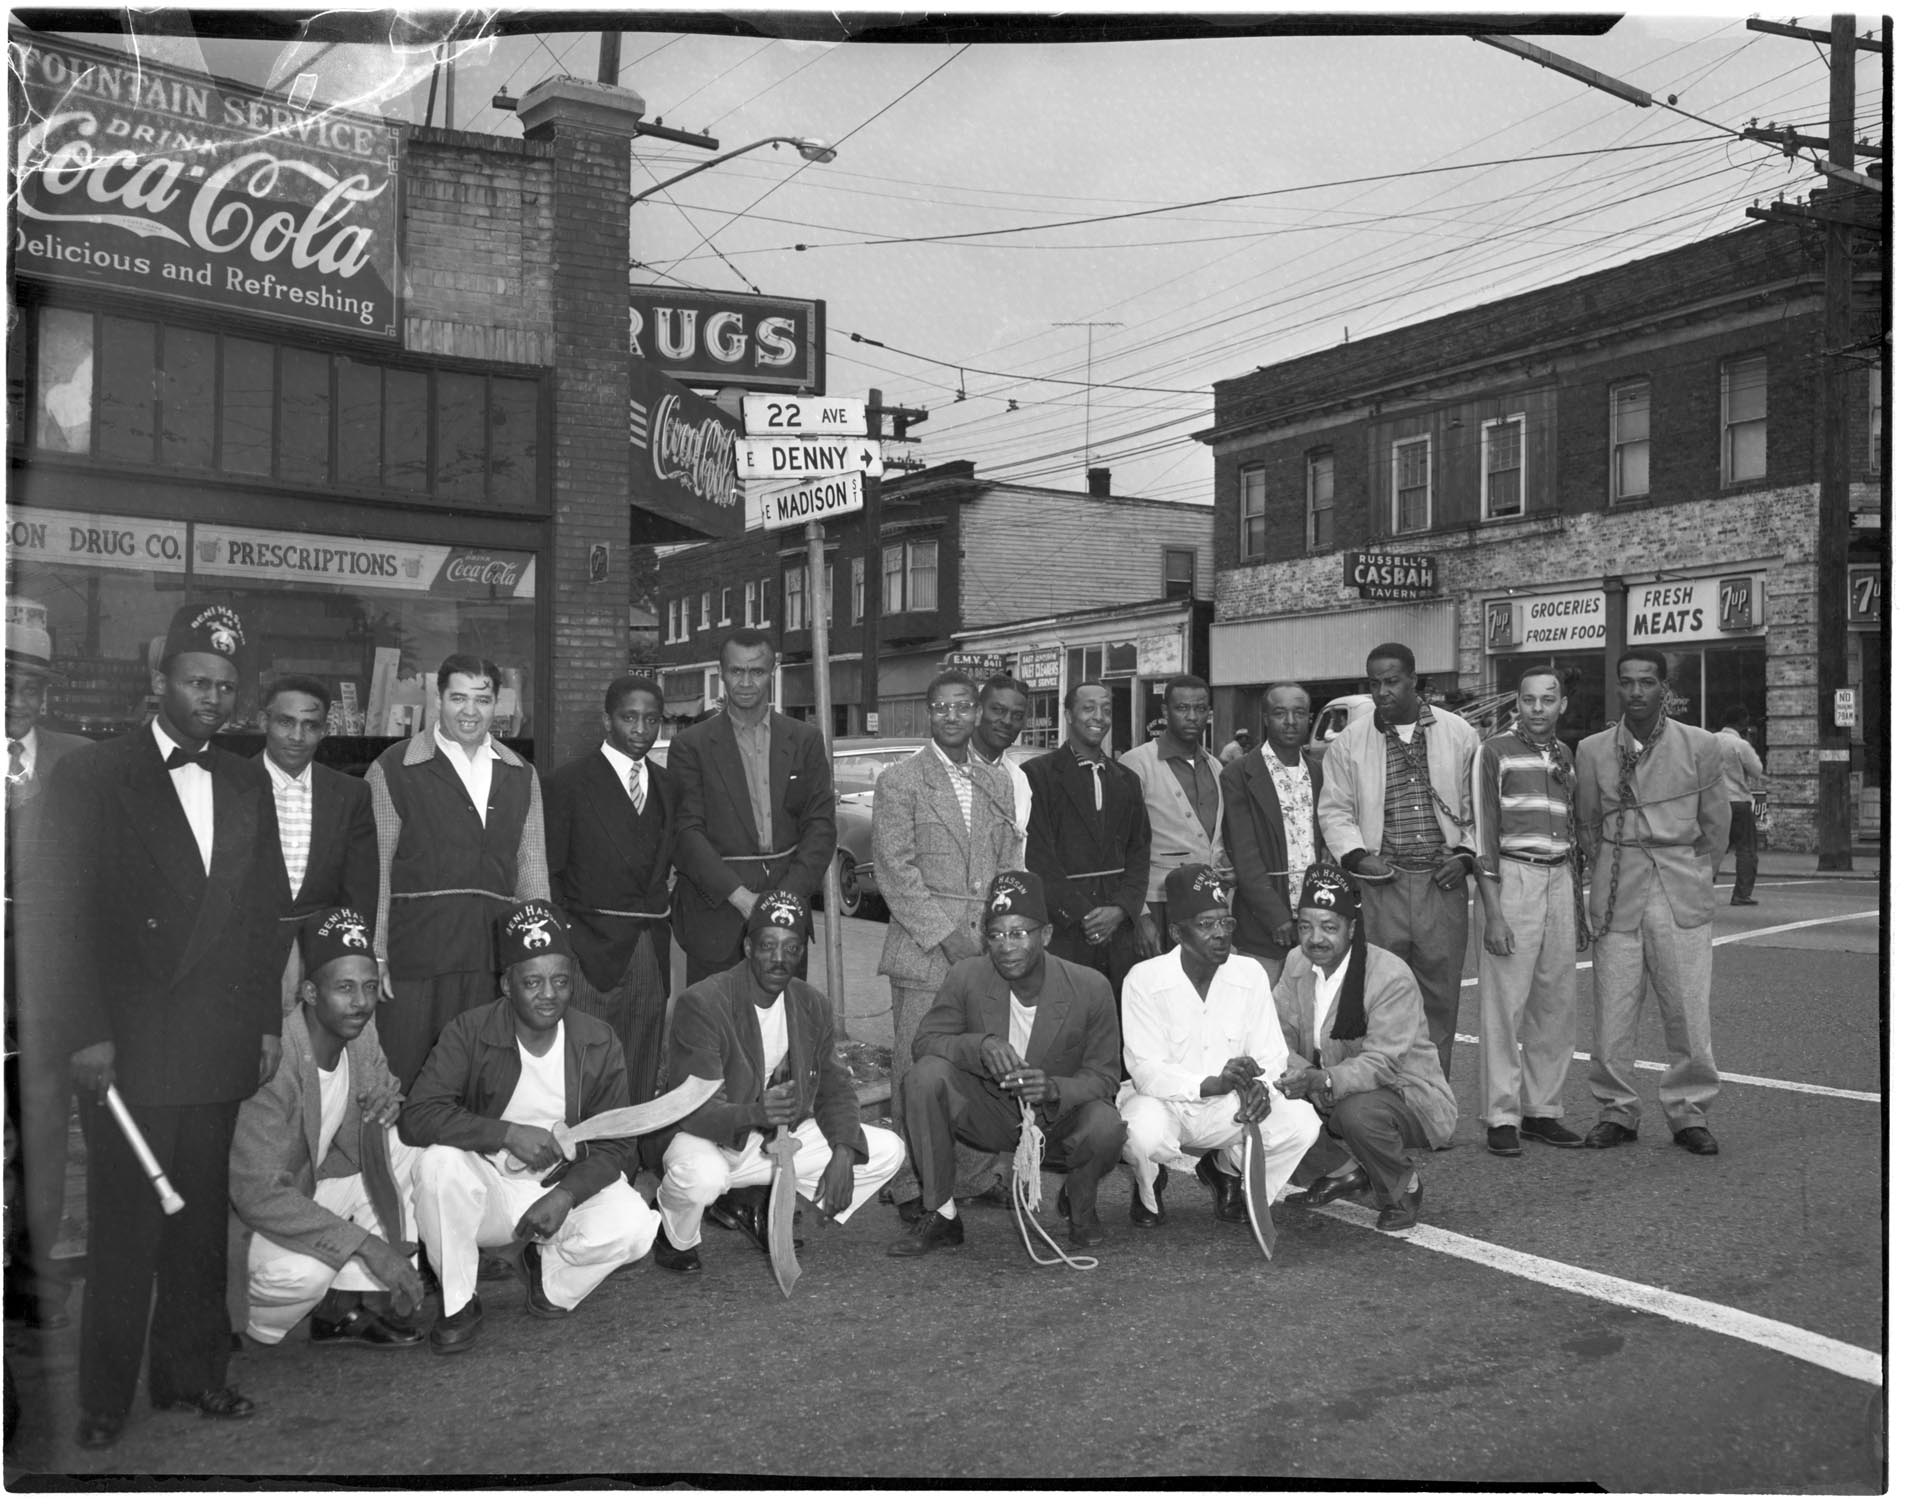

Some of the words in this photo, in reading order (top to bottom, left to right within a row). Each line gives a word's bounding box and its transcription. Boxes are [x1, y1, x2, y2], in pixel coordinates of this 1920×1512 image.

[105, 118, 217, 156] DRINK
[224, 96, 374, 155] SERVICE
[17, 111, 389, 279] Coca-Cola
[162, 262, 212, 287] and
[226, 266, 375, 325] Refreshing
[767, 403, 802, 427] 22
[821, 408, 848, 424] AVE
[746, 451, 754, 467] E
[771, 446, 848, 471] DENNY
[765, 504, 772, 520] E
[776, 481, 848, 521] MADISON
[6, 521, 48, 549] ON
[69, 527, 136, 556] DRUG
[145, 534, 182, 560] CO.
[228, 540, 399, 577] PRESCRIPTIONS
[446, 556, 519, 586] Coca-Cola
[1359, 554, 1428, 568] RUSSELL'S
[1354, 564, 1433, 588] CASBAH
[1369, 587, 1417, 599] TAVERN
[1643, 586, 1694, 608] FRESH
[1531, 597, 1601, 619] GROCERIES
[1526, 627, 1568, 643] FROZEN
[1570, 624, 1606, 640] FOOD
[1633, 608, 1704, 636] MEATS
[1839, 692, 1851, 702] NO
[317, 912, 341, 937] BENI
